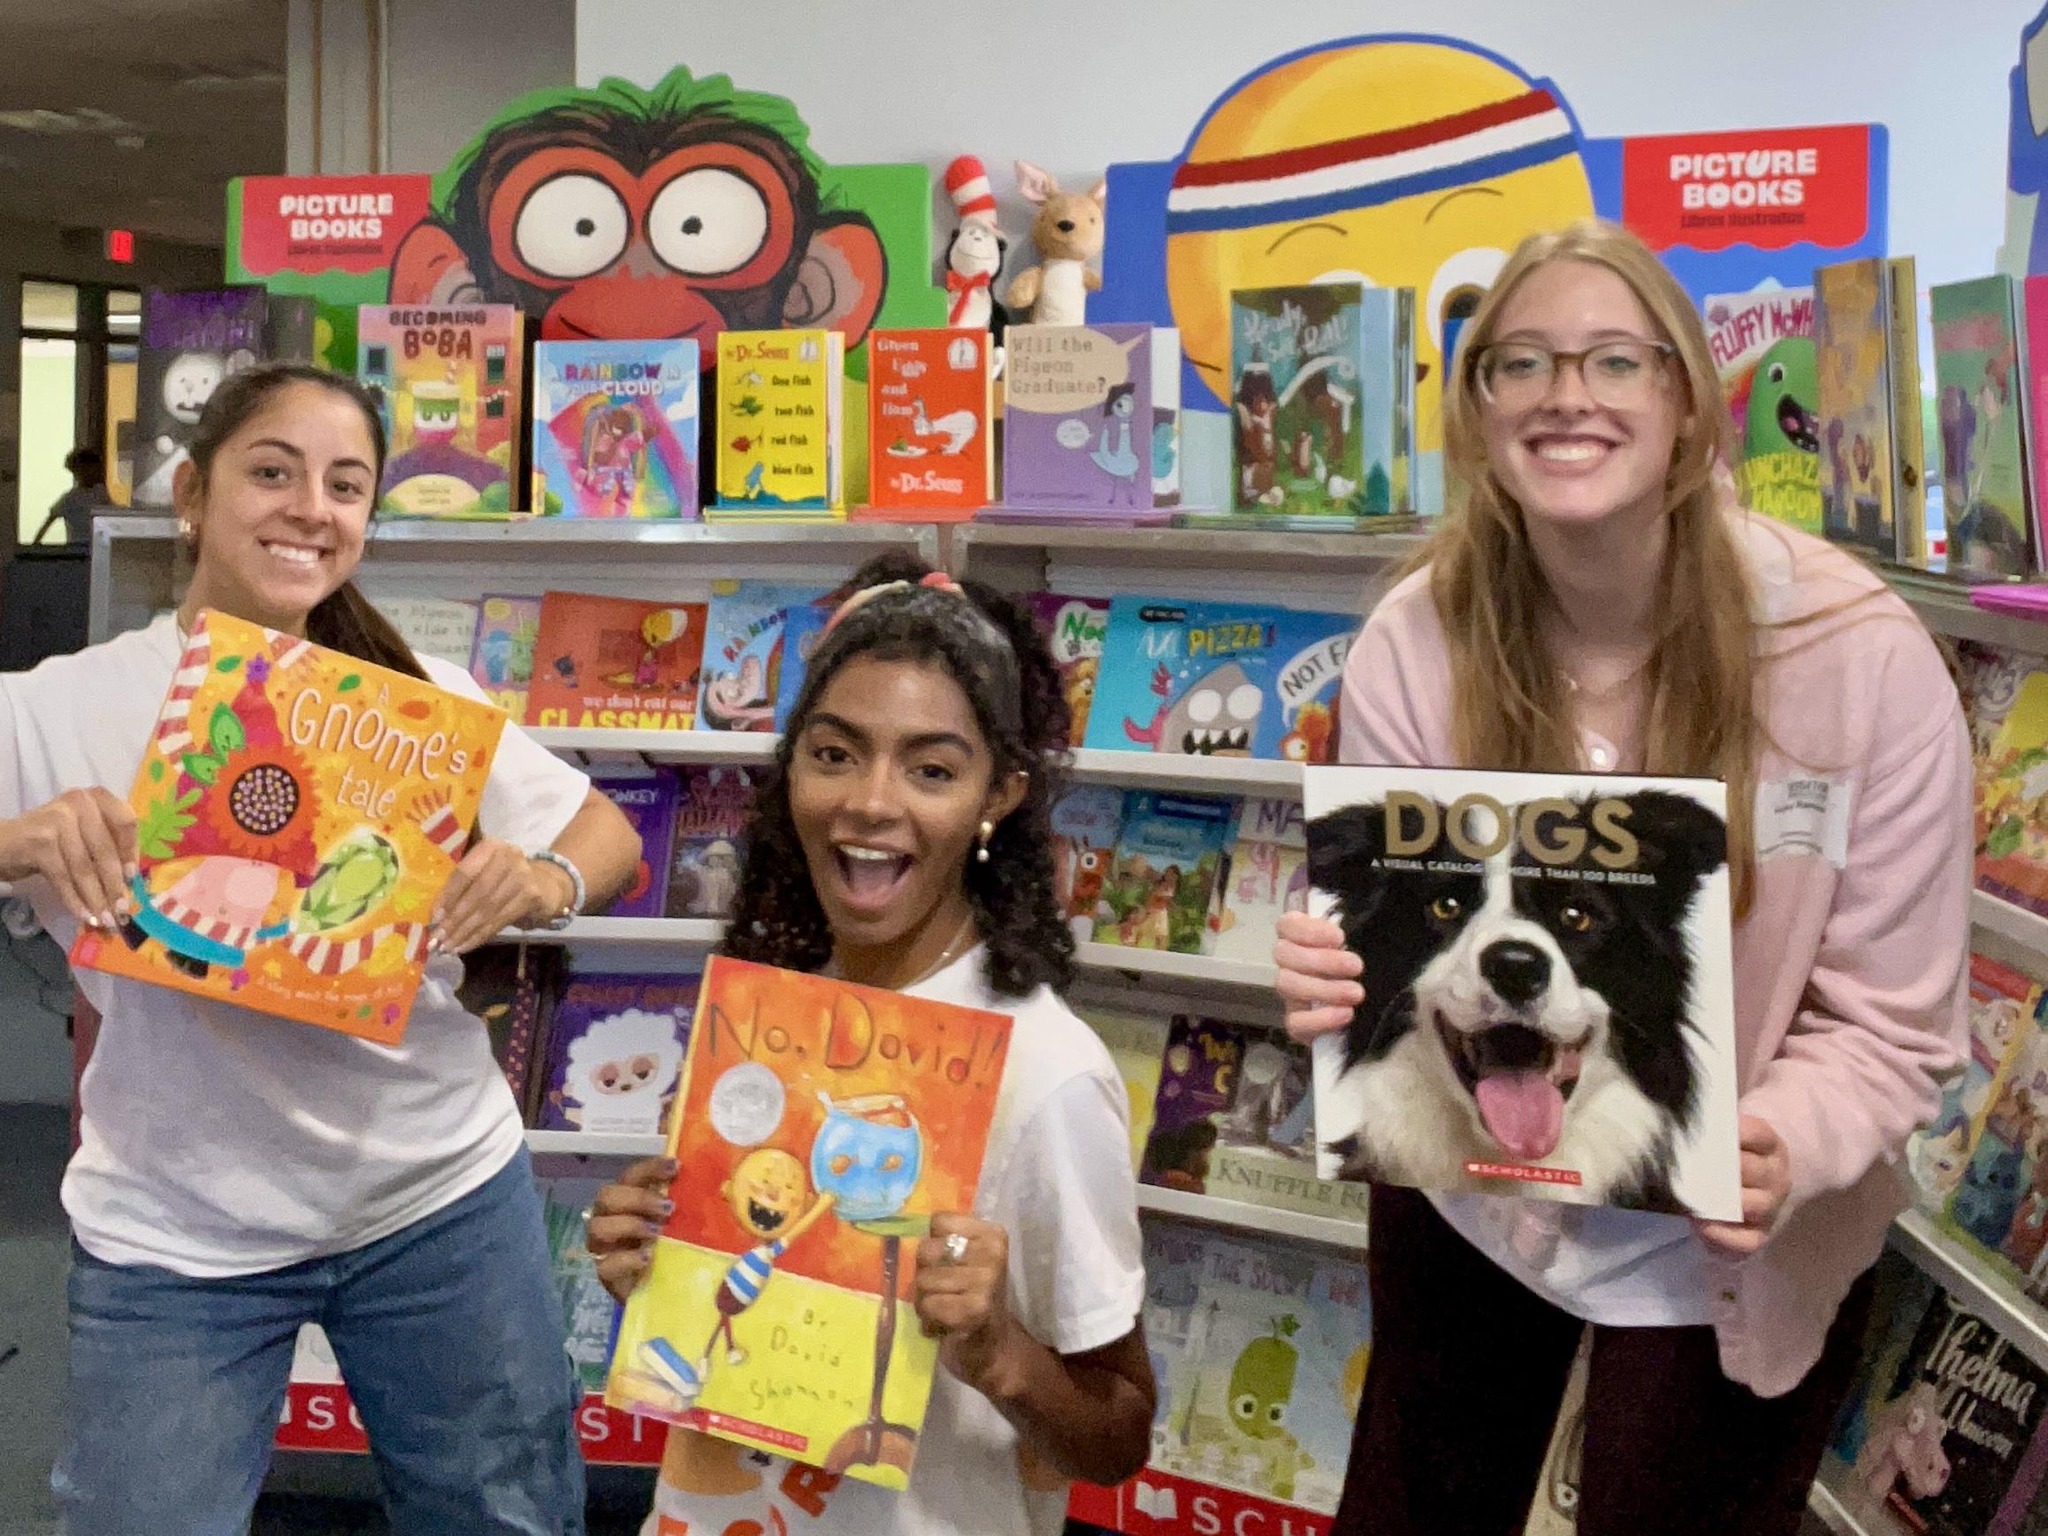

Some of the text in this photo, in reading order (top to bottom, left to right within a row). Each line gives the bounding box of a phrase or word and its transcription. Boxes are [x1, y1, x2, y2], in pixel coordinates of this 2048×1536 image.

[1670, 148, 1817, 181] PICTURE
[1682, 179, 1804, 209] BOOKS
[280, 194, 394, 216] PICTURE
[291, 219, 383, 240] BOOKS
[389, 309, 487, 326] BECOMING
[1012, 336, 1093, 353] Will the
[1710, 304, 1765, 368] FLUFFY
[756, 340, 790, 361] Seuss
[564, 362, 662, 381] RAINBOW
[1012, 356, 1075, 377] Pigeon
[601, 381, 665, 396] CLOUD
[792, 374, 812, 386] fish
[880, 382, 908, 396] and
[1010, 376, 1107, 395] Graduate?
[795, 404, 815, 416] fish
[789, 434, 808, 446] fish
[795, 463, 814, 475] fish
[901, 471, 924, 493] Dr.
[925, 469, 964, 494] Seuss
[1282, 652, 1324, 698] NOT
[288, 682, 468, 781] A Gnome's
[336, 764, 396, 819] tale
[1385, 789, 1641, 869] DOGS
[824, 988, 1004, 1090] David!
[1216, 1156, 1333, 1203] KNUFFLE
[1480, 1164, 1579, 1183] SCHOLASTIC
